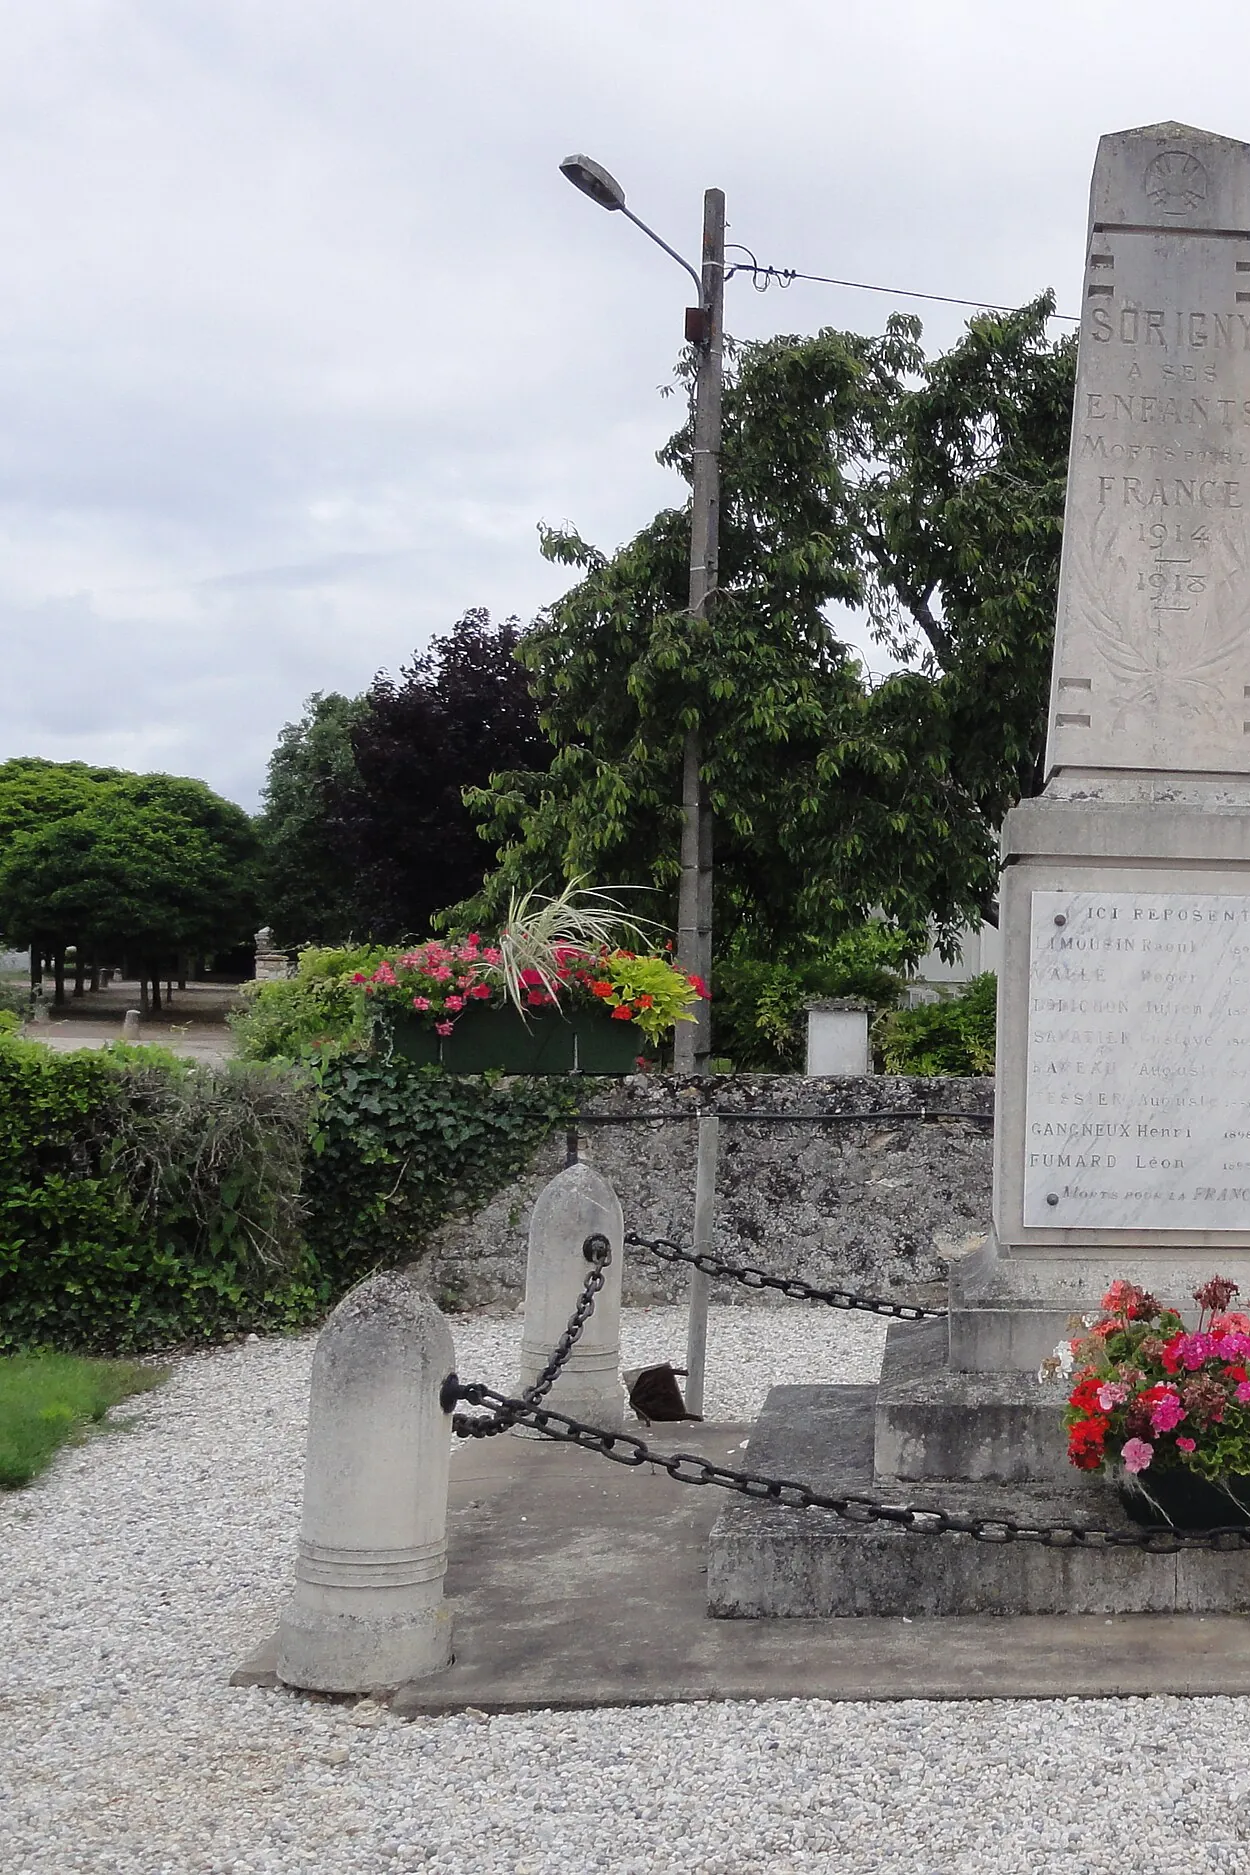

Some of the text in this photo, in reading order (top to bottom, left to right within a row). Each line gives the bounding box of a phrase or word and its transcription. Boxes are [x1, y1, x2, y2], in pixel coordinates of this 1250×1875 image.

[1162, 363, 1218, 383] SES
[1098, 476, 1244, 509] FRANCE
[1137, 523, 1212, 550] 1914
[1136, 572, 1208, 600] 1918
[1087, 907, 1250, 922] ICI REPOSENT
[1035, 936, 1135, 951] LIMOUSIN
[1137, 1123, 1192, 1138] Henri
[1029, 1153, 1117, 1168] FUMARD
[1136, 1154, 1185, 1169] Léon
